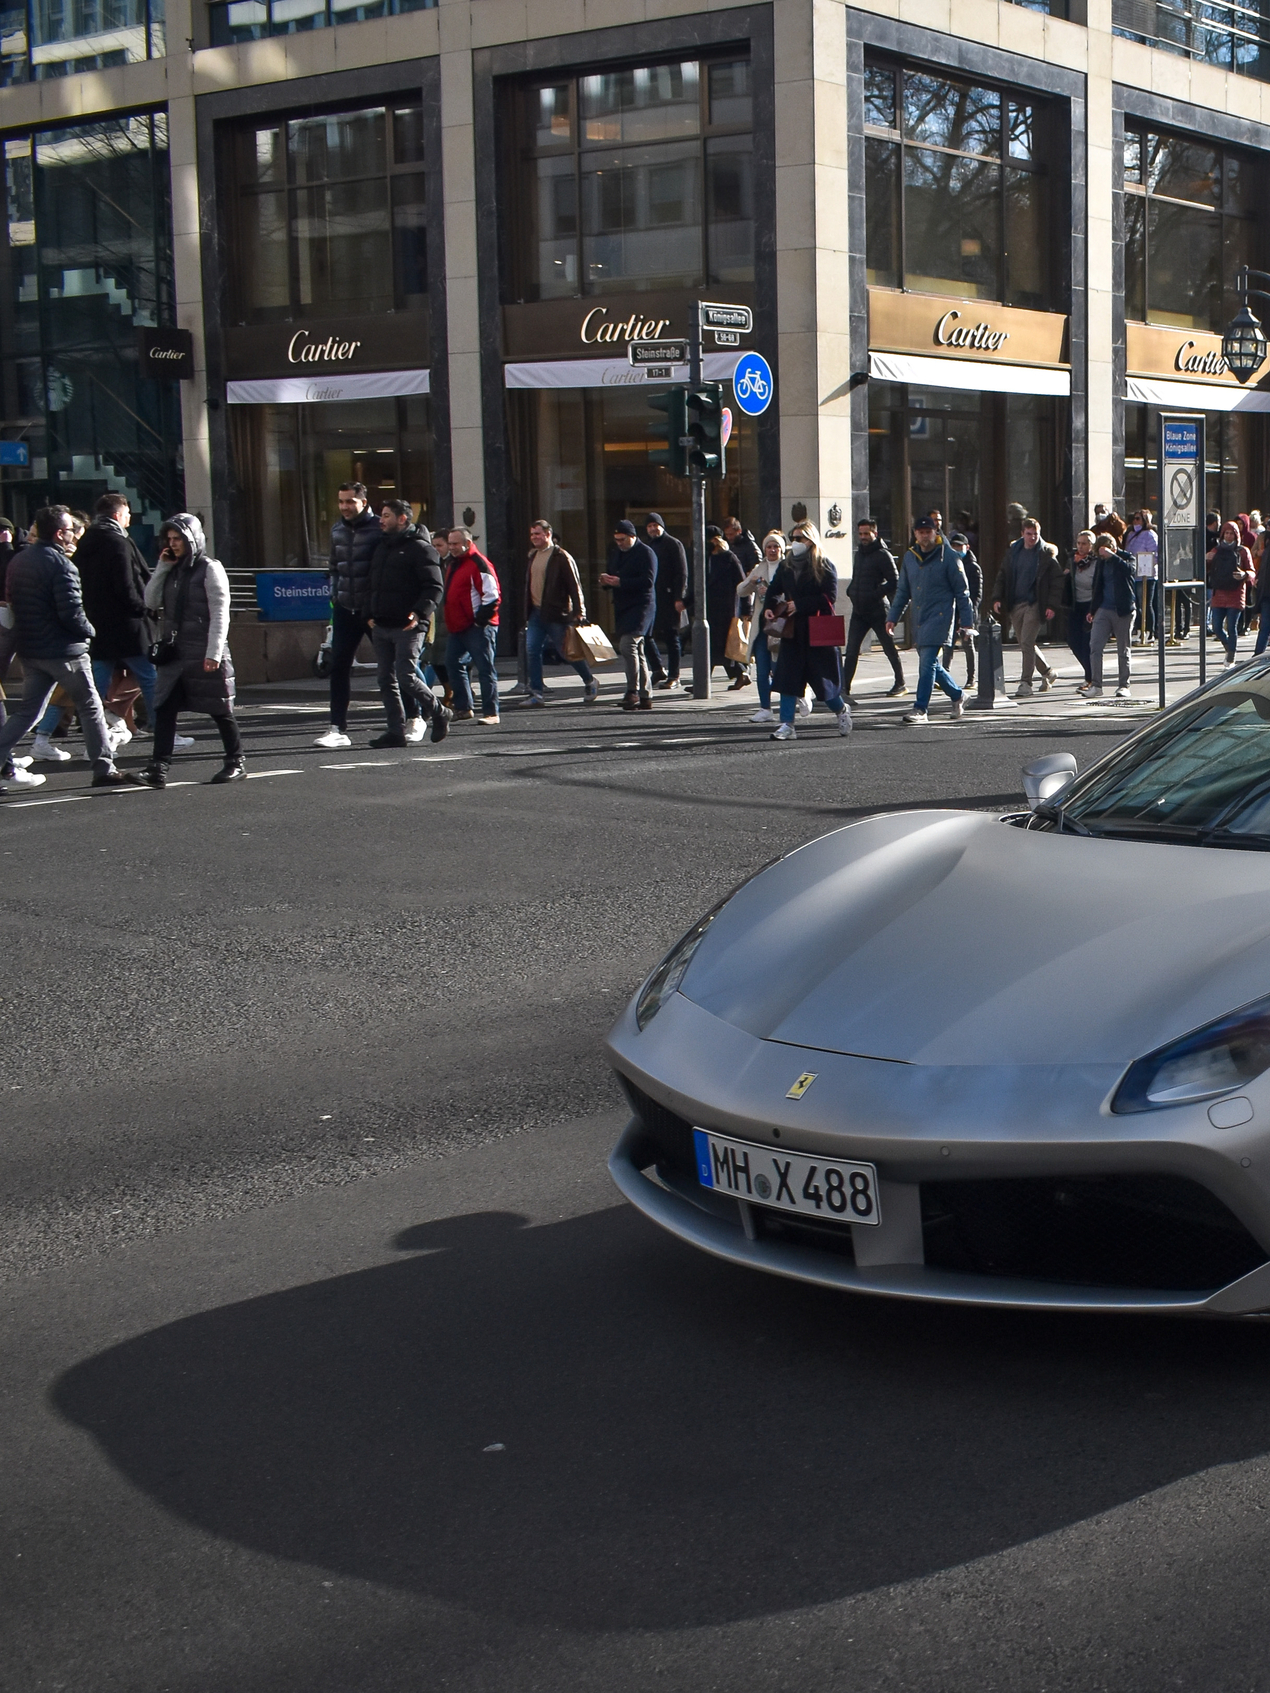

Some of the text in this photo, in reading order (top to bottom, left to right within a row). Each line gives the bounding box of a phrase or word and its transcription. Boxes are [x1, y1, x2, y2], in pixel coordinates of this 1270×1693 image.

[581, 307, 669, 344] Cartier
[936, 310, 1010, 351] Cartier
[149, 347, 185, 360] Cartier
[288, 330, 361, 364] Cartier
[636, 347, 680, 360] Steinstraße
[601, 366, 645, 385] Cartier
[305, 383, 343, 401] Cartier
[1166, 431, 1196, 440] Blaue Zone
[1172, 513, 1190, 523] ZONE
[274, 586, 330, 597] Steinstraß
[711, 1142, 873, 1217] MH X 488
